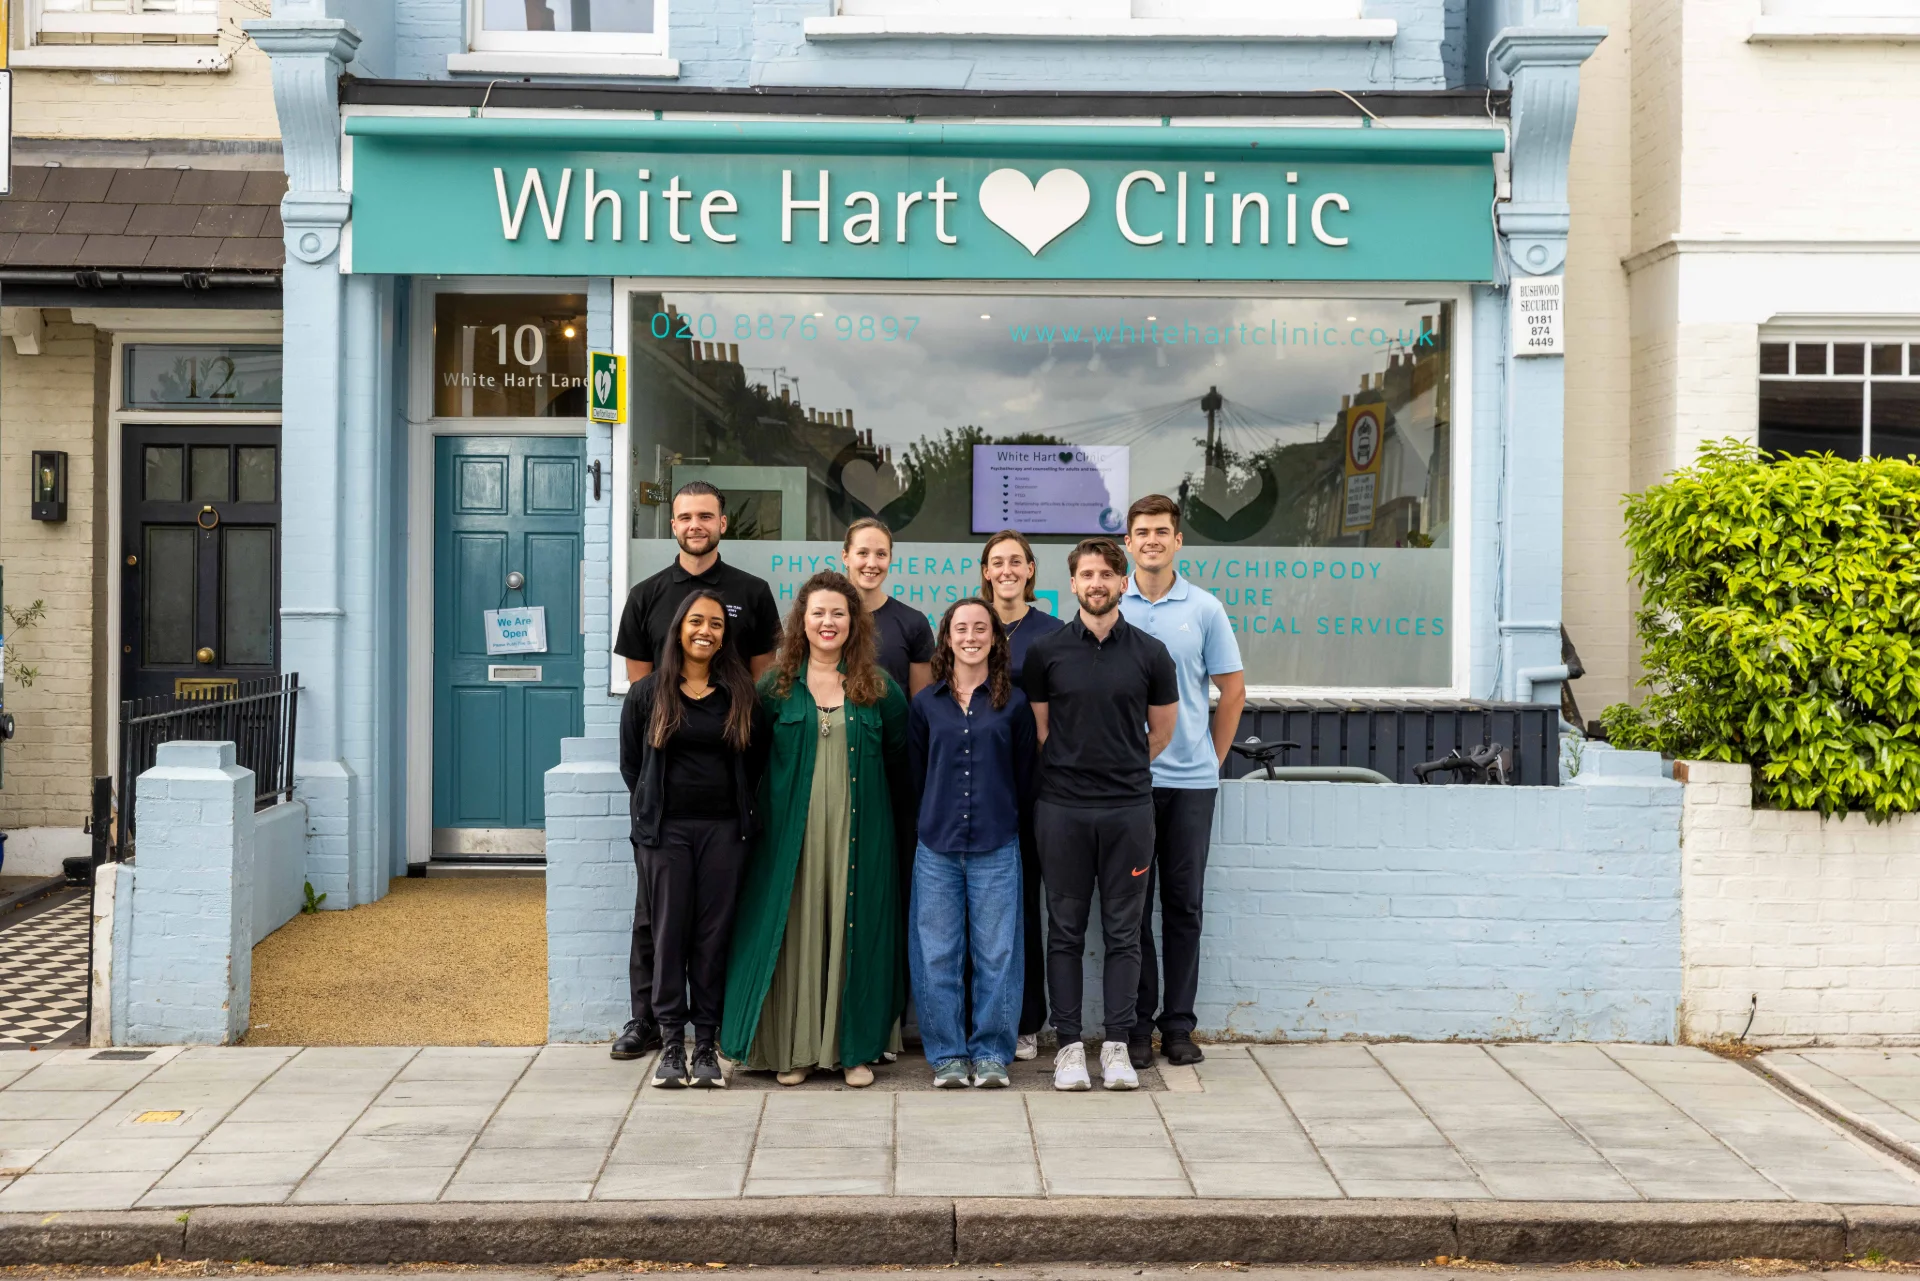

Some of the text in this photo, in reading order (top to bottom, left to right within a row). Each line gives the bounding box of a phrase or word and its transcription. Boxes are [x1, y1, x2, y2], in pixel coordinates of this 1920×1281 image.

[494, 167, 1350, 245] White Hart Clinic
[1520, 284, 1560, 297] BUSHWOOD
[1520, 299, 1560, 312] SECURITY
[1527, 315, 1552, 324] 0181
[651, 312, 921, 342] 020 8876 9897
[1009, 317, 1434, 347] www.whitehartclinic.co.uk
[1531, 326, 1550, 336] 874
[491, 323, 544, 366] 10
[1528, 337, 1554, 347] 4449
[184, 355, 237, 399] 12
[443, 372, 589, 387] White Hart Lane
[593, 408, 617, 419] Defibrillator
[997, 451, 1030, 462] White
[1033, 451, 1057, 462] Hart
[1178, 559, 1381, 579] RY/CHIROPODY
[497, 617, 532, 627] We Are
[1228, 616, 1445, 636] GICAL SERVICES
[502, 629, 528, 639] Open
